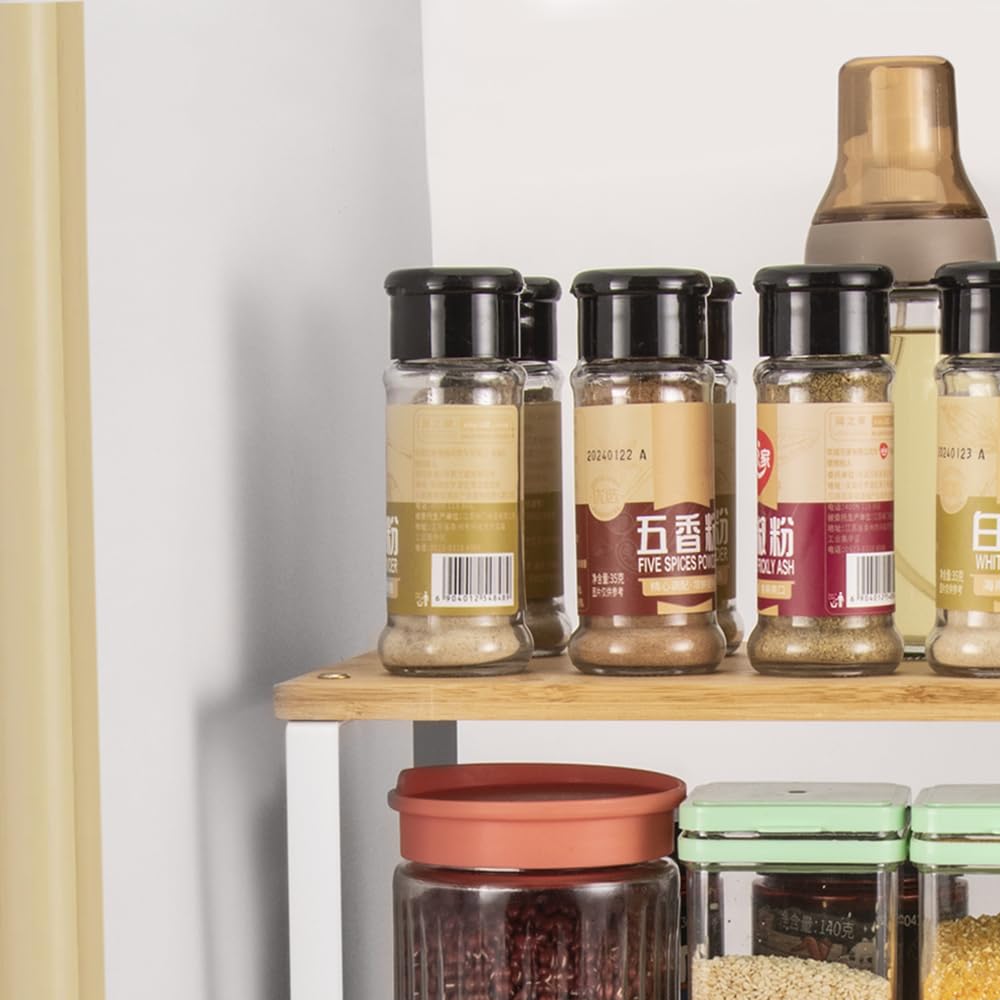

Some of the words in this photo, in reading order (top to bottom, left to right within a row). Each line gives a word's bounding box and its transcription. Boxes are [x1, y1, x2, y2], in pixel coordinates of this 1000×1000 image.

[587, 449, 633, 462] 20240122
[640, 449, 647, 461] A
[938, 447, 973, 460] 0240123
[978, 448, 985, 460] A
[638, 557, 662, 573] FIVE
[664, 555, 698, 572] SPICES
[777, 559, 795, 576] ASH
